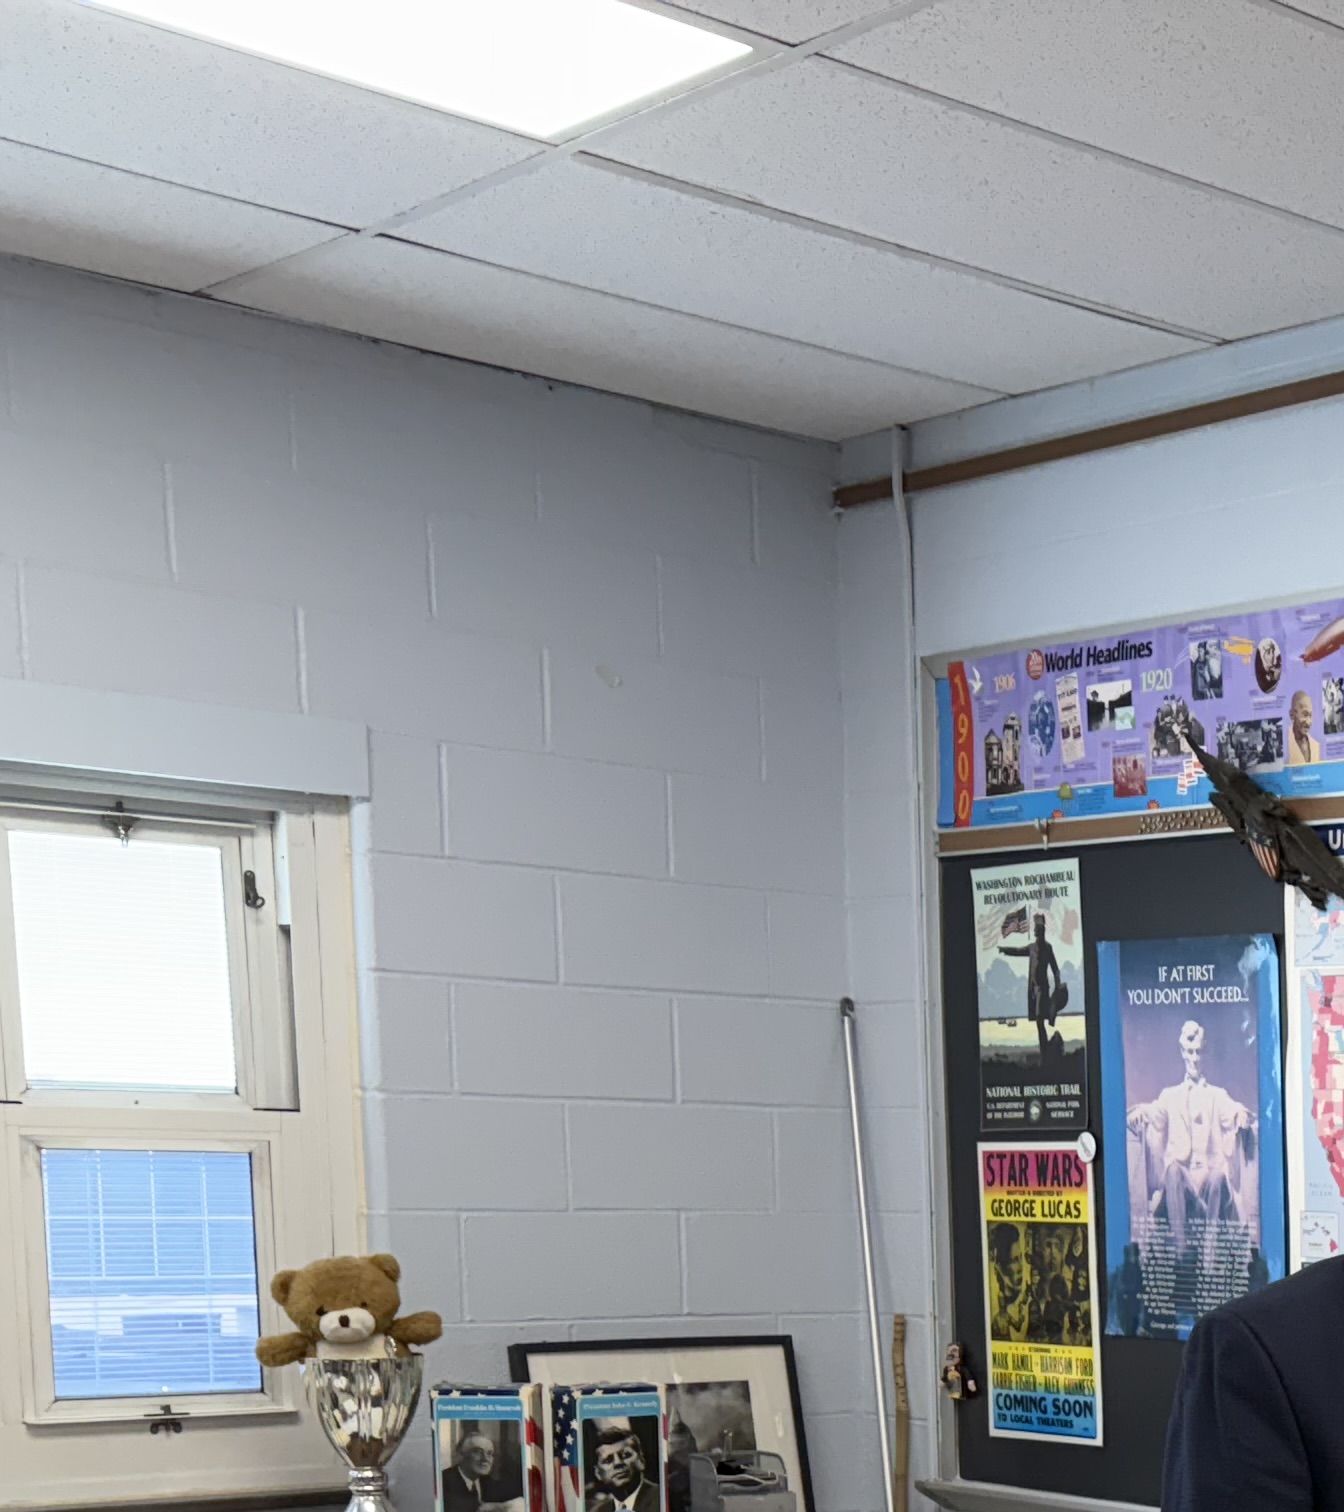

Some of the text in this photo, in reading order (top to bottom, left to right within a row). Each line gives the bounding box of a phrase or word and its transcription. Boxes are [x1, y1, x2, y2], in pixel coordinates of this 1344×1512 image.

[1044, 646, 1083, 673] World
[1086, 640, 1153, 667] Headlines
[992, 672, 1017, 694] 1906
[1140, 669, 1173, 694] 1920
[975, 876, 1023, 891] WASHINGTON
[983, 886, 1069, 905] REVOLUTIONARY ROUTE
[1158, 965, 1215, 983] IF AT FIRST
[1127, 988, 1152, 1005] YOU
[1154, 987, 1191, 1004] DON'T
[986, 1083, 1082, 1098] NATIONAL HISTORIC TRAIL
[986, 1153, 1084, 1188] STAR WARS
[990, 1198, 1081, 1219] GEORGE LUCAS
[992, 1351, 1009, 1370] MARK
[1040, 1355, 1074, 1376] HARRISON
[1075, 1358, 1094, 1377] FORD
[1043, 1376, 1061, 1395] ALEX
[995, 1392, 1094, 1419] COMING SOON
[997, 1412, 1075, 1429] TO LOCAL THEATERS
